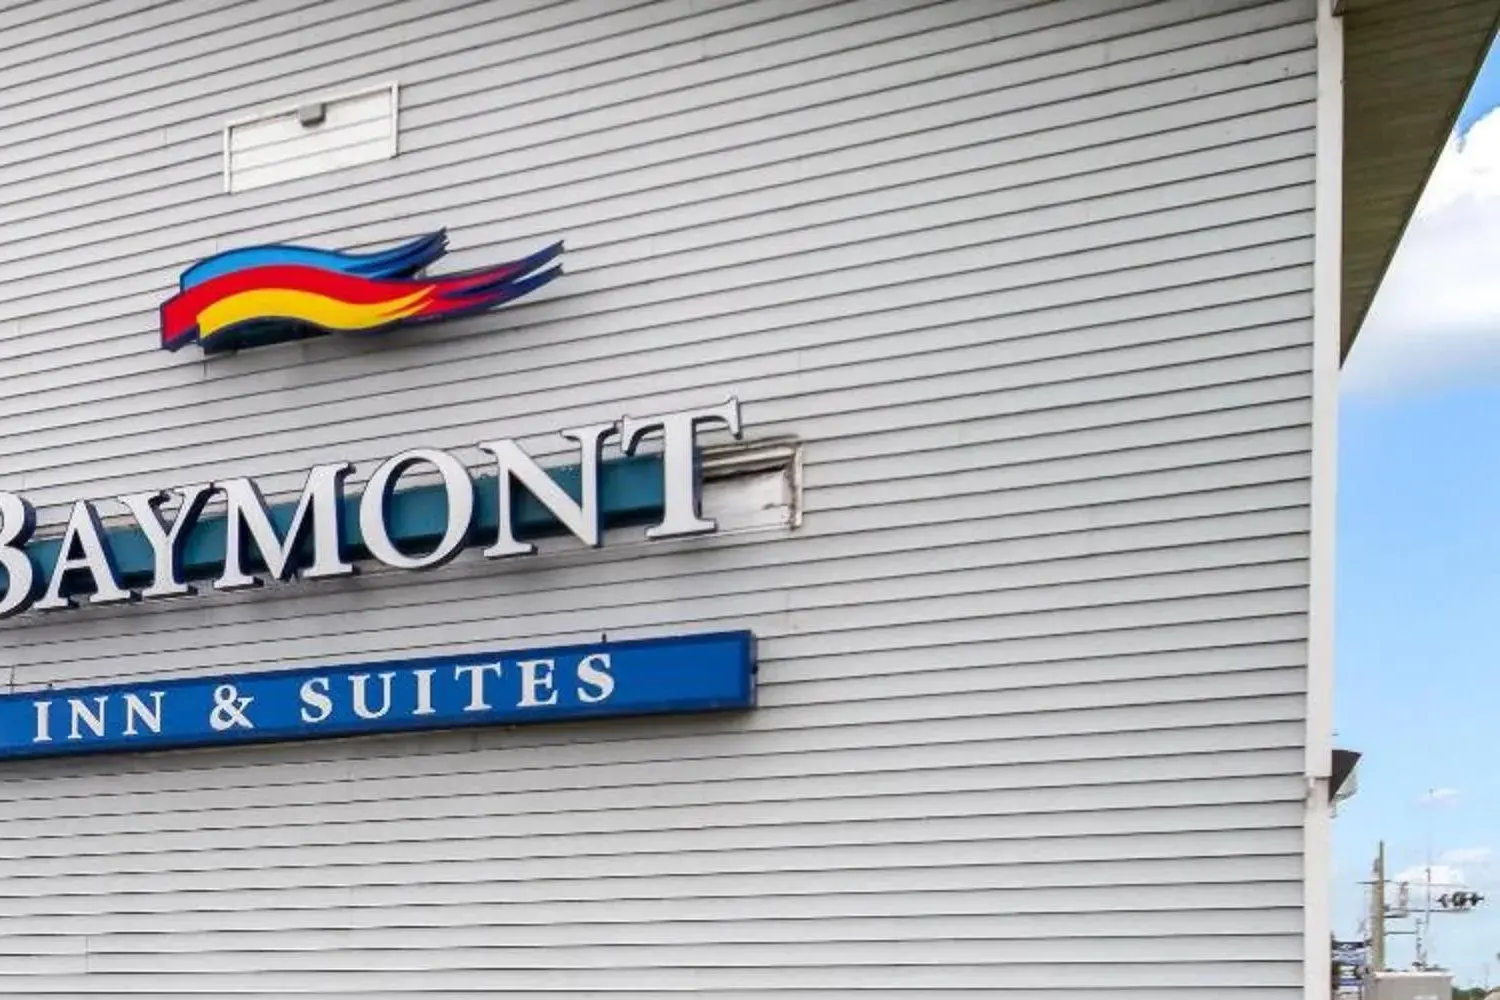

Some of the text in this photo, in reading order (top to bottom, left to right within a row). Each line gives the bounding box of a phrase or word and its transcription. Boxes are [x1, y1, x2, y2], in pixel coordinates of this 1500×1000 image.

[33, 653, 615, 742] INN & SUITES
